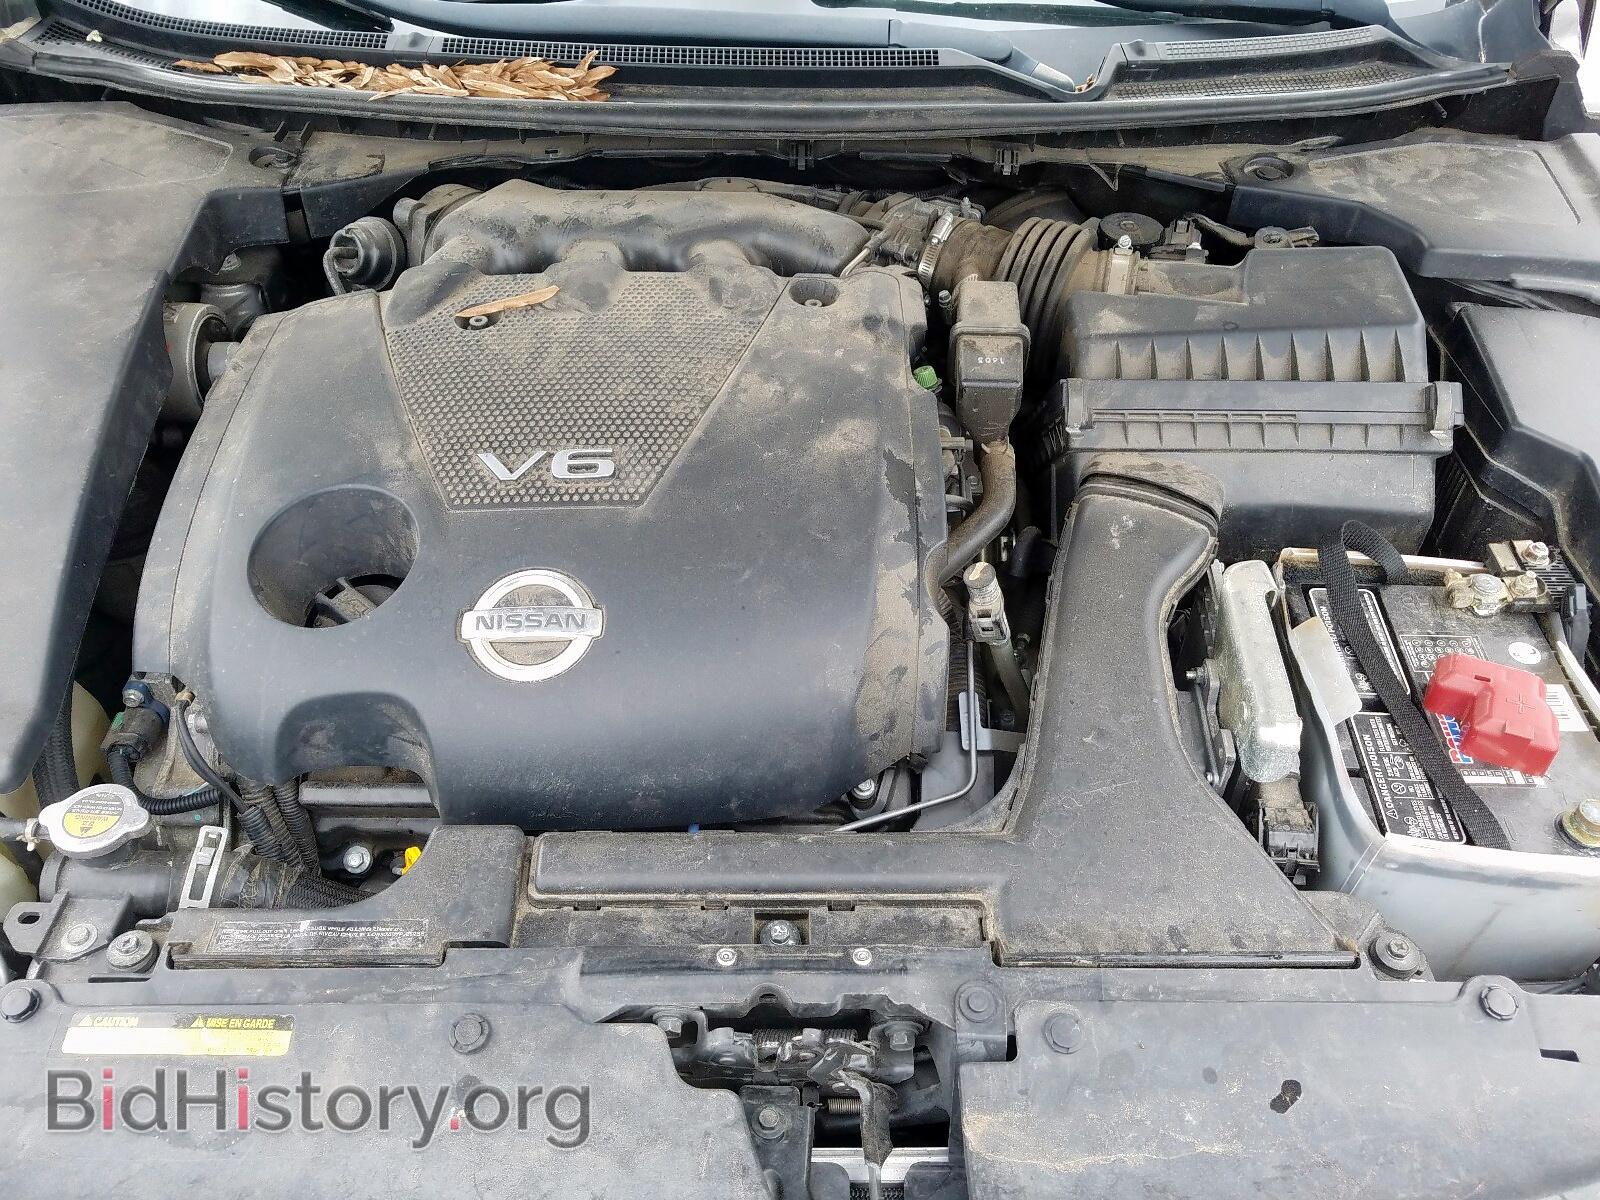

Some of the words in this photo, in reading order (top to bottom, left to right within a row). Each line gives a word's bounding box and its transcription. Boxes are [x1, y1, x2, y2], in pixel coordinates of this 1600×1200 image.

[477, 449, 615, 480] V6
[475, 612, 586, 631] NISSAN
[93, 1016, 139, 1027] CAUTION
[206, 1017, 227, 1028] MISE
[229, 1018, 243, 1028] EN
[243, 1018, 275, 1029] GARDE
